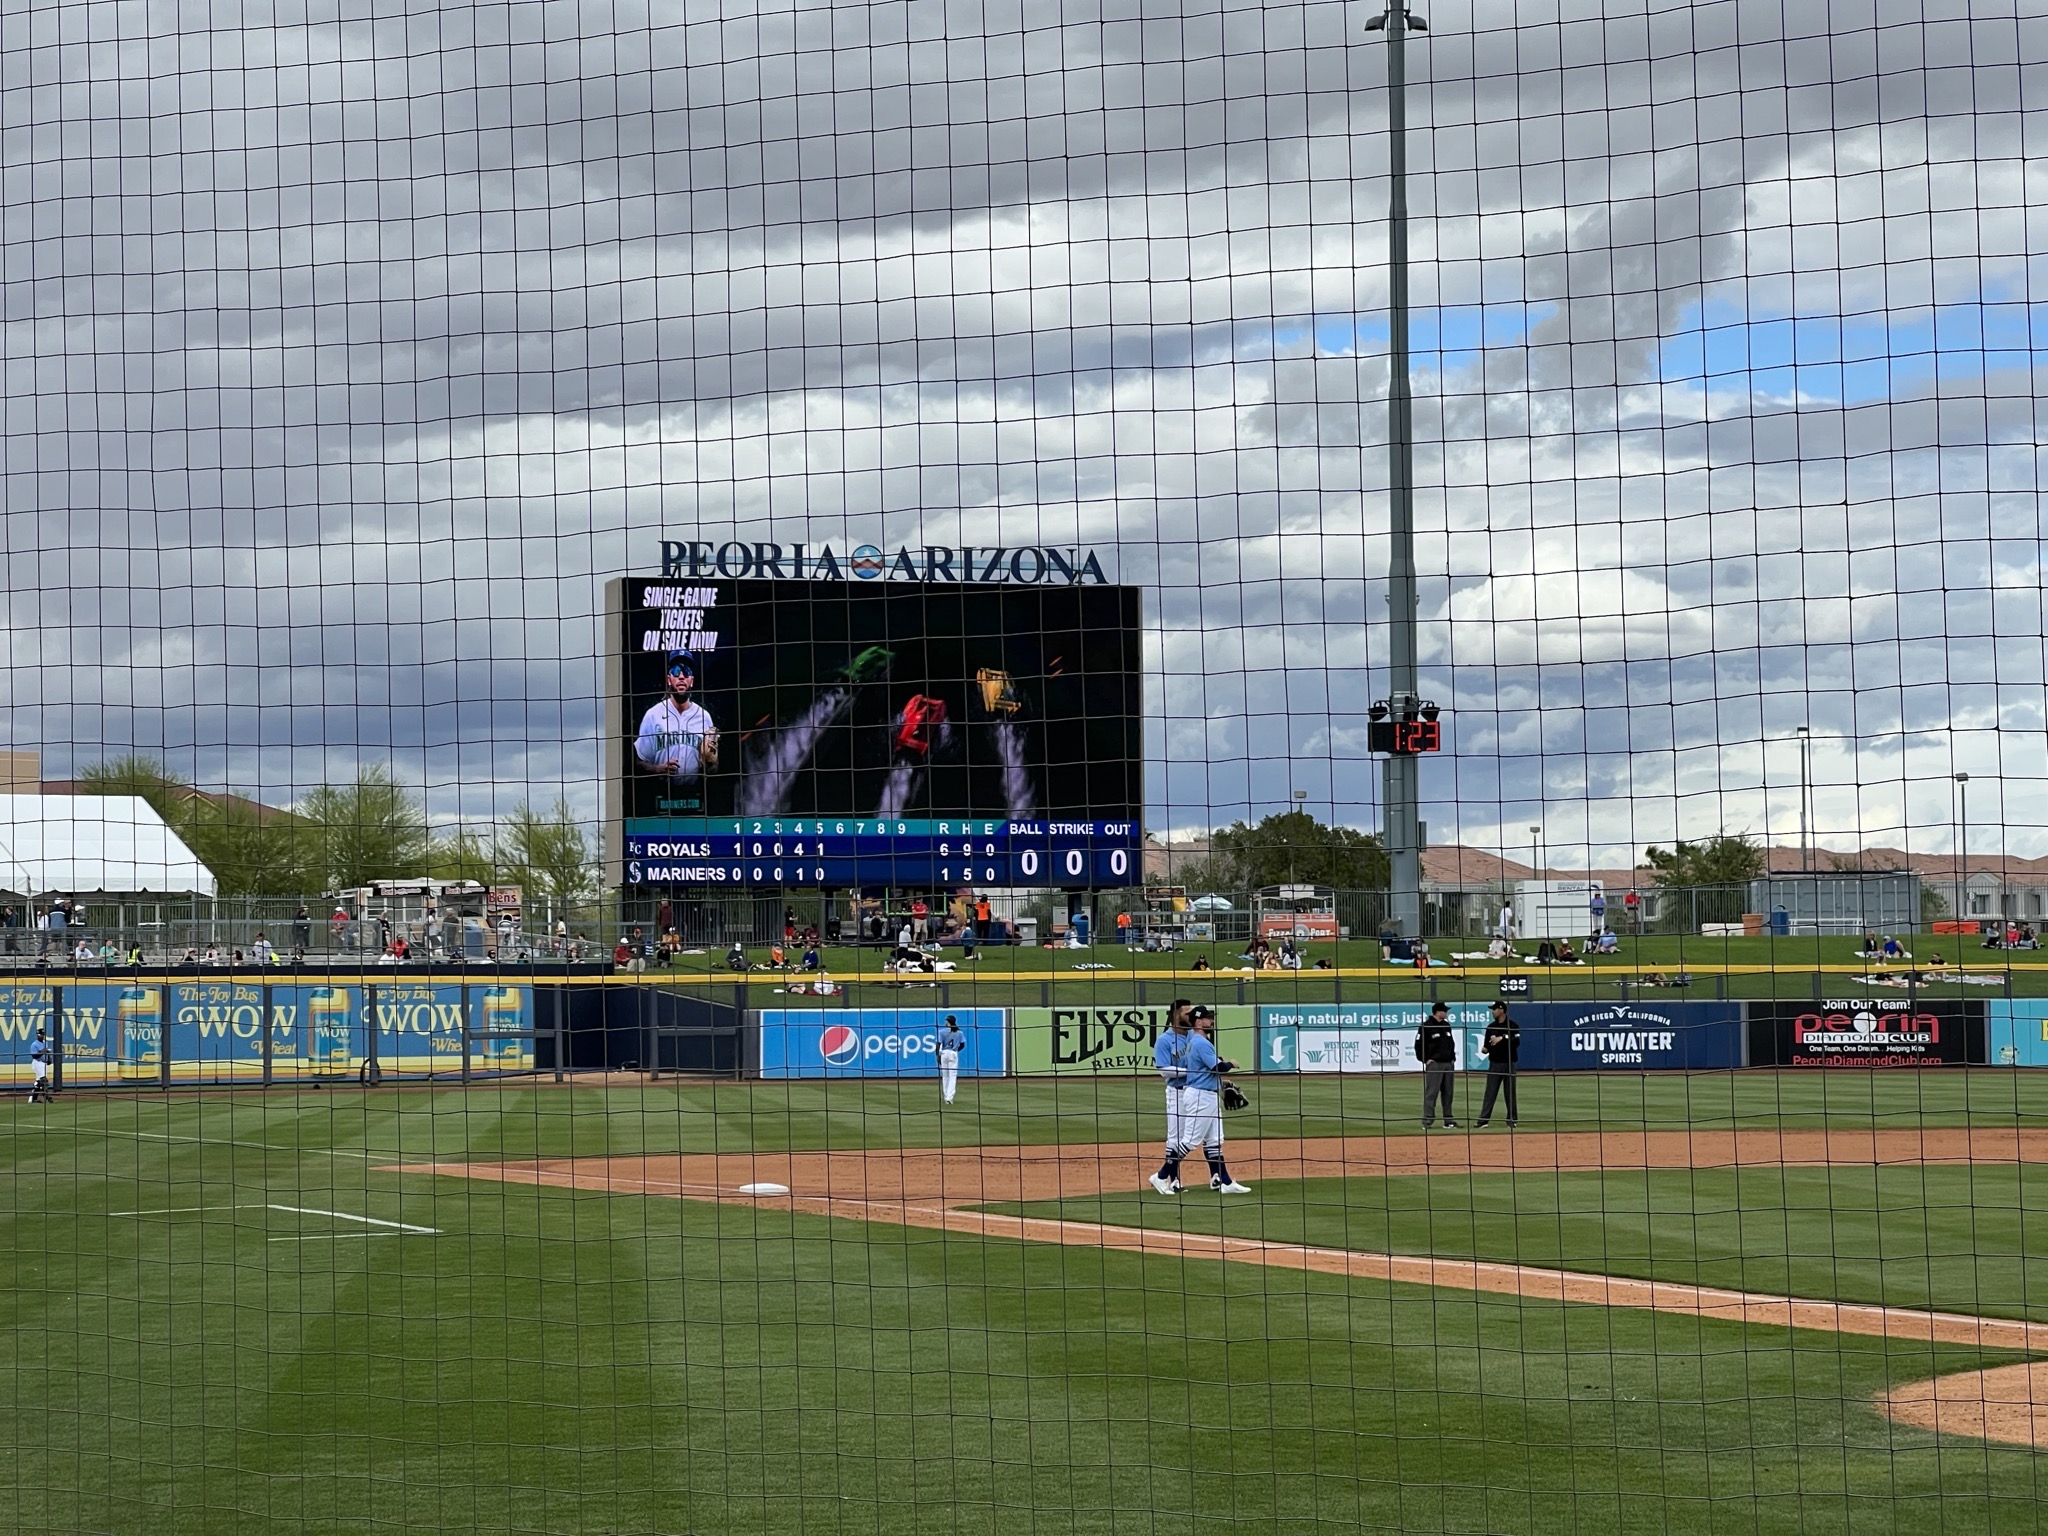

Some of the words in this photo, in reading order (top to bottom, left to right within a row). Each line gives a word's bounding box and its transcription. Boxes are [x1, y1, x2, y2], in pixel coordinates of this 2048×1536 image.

[658, 541, 845, 579] PEORIA
[887, 545, 1109, 584] ARIZONA
[643, 586, 718, 608] SINGLE-GAME
[660, 609, 704, 630] TICKETS
[643, 630, 660, 651] ON
[661, 630, 689, 651] SALE
[689, 631, 718, 652] NOW
[1395, 722, 1439, 751] 1:23
[734, 823, 740, 834] 1
[753, 823, 762, 834] 2
[774, 823, 782, 834] 3
[794, 823, 803, 834] 4
[816, 823, 824, 834] 5
[836, 823, 844, 834] 6
[857, 823, 865, 834] 7
[878, 823, 886, 834] 8
[898, 823, 906, 834] 9
[939, 824, 949, 834] R
[962, 824, 971, 834] H
[985, 824, 994, 834] E
[1010, 823, 1042, 835] BALL
[1050, 823, 1094, 835] STRIKE
[1105, 824, 1131, 835] OUT
[648, 843, 710, 857] ROYALS
[734, 843, 741, 856] 1
[753, 843, 762, 856] 0
[774, 843, 782, 856] 0
[794, 843, 804, 856] 4
[818, 843, 824, 856] 1
[940, 844, 948, 856] 6
[963, 844, 971, 856] 9
[986, 844, 994, 856] 0
[1021, 849, 1038, 875] 0
[1066, 849, 1082, 875] 0
[1111, 849, 1127, 875] 0
[648, 868, 726, 881] MARINERS
[732, 868, 741, 881] 0
[753, 868, 762, 881] 0
[774, 868, 782, 881] 0
[796, 868, 803, 881] 1
[815, 868, 824, 881] 0
[941, 868, 948, 881] 1
[963, 868, 972, 881] 5
[986, 868, 995, 881] 0
[178, 987, 207, 1001] The
[208, 987, 231, 1003] Joy
[234, 987, 258, 1003] Bus
[388, 986, 412, 1002] Joy
[412, 986, 437, 1002] Bus
[1822, 1000, 1848, 1010] Join
[1850, 1000, 1873, 1010] Our
[1876, 1000, 1911, 1010] Team!
[178, 1005, 297, 1038] WOW
[361, 1004, 473, 1036] WOW
[1269, 1013, 1304, 1025] Have
[1308, 1012, 1357, 1024] natural
[1362, 1014, 1398, 1026] grass
[1460, 1010, 1490, 1022] this!
[1574, 1015, 1589, 1027] SAN
[1592, 1012, 1614, 1021] DIEGO
[1628, 1011, 1671, 1026] CALIFORNIA
[1052, 1010, 1214, 1064] ELYSI
[1324, 1041, 1339, 1049] WEST
[1341, 1041, 1359, 1049] COAST
[1889, 1033, 1930, 1043] CLUB
[865, 1035, 942, 1059] peps
[1325, 1049, 1359, 1063] TURF
[1602, 1053, 1642, 1064] SPIRITS
[1793, 1055, 1942, 1066] PeoraDiamondCluborg
